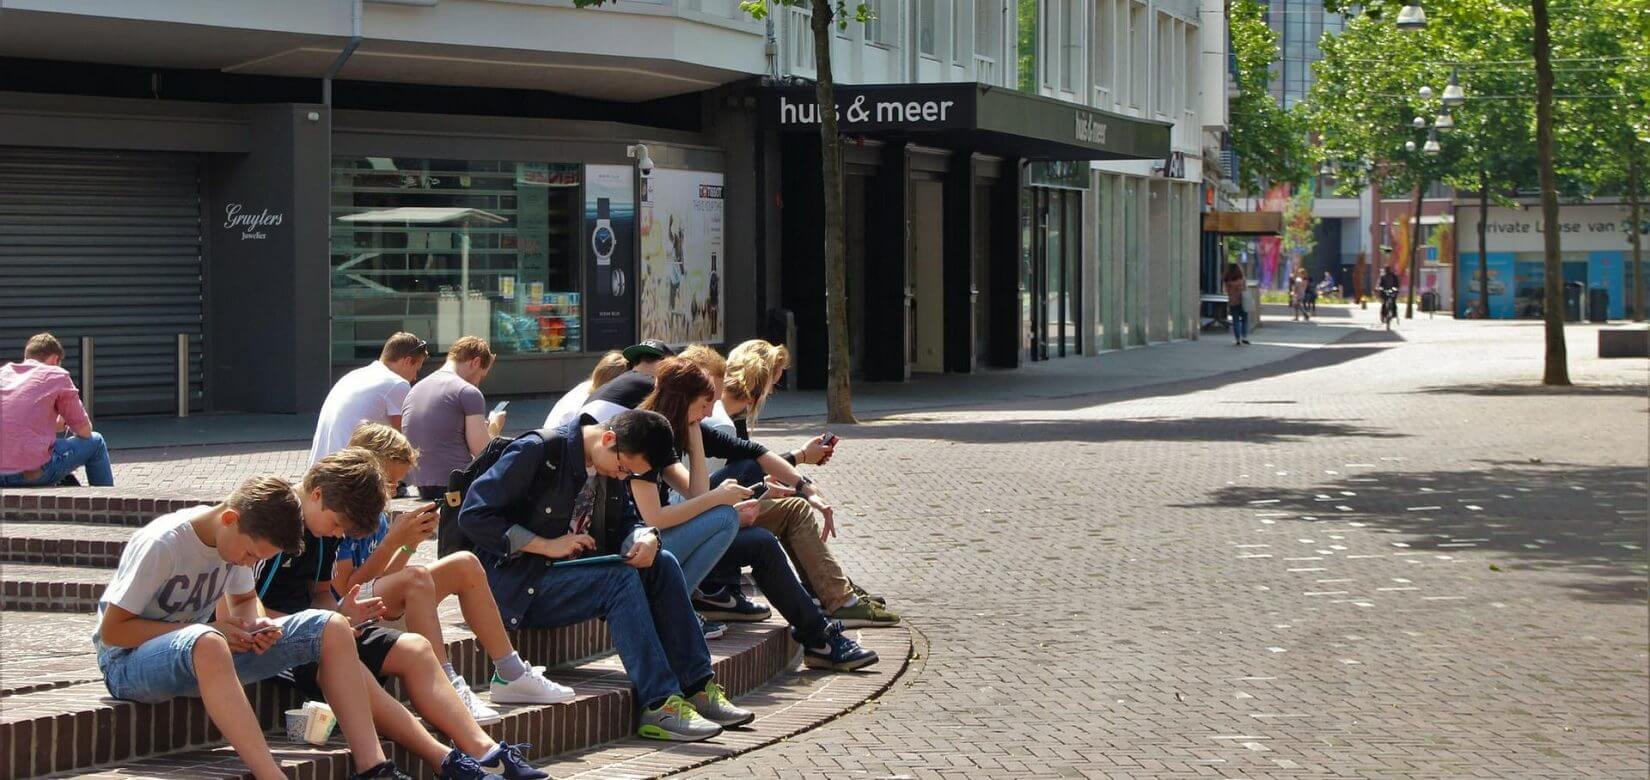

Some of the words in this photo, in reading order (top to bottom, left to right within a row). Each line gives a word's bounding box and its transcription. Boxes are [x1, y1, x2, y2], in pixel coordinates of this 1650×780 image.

[847, 95, 870, 123] &
[877, 101, 954, 122] meer
[1075, 110, 1087, 141] huis
[1093, 121, 1107, 144] meer
[1477, 220, 1530, 233] rivate
[1535, 220, 1581, 233] Lse
[1588, 222, 1615, 233] van
